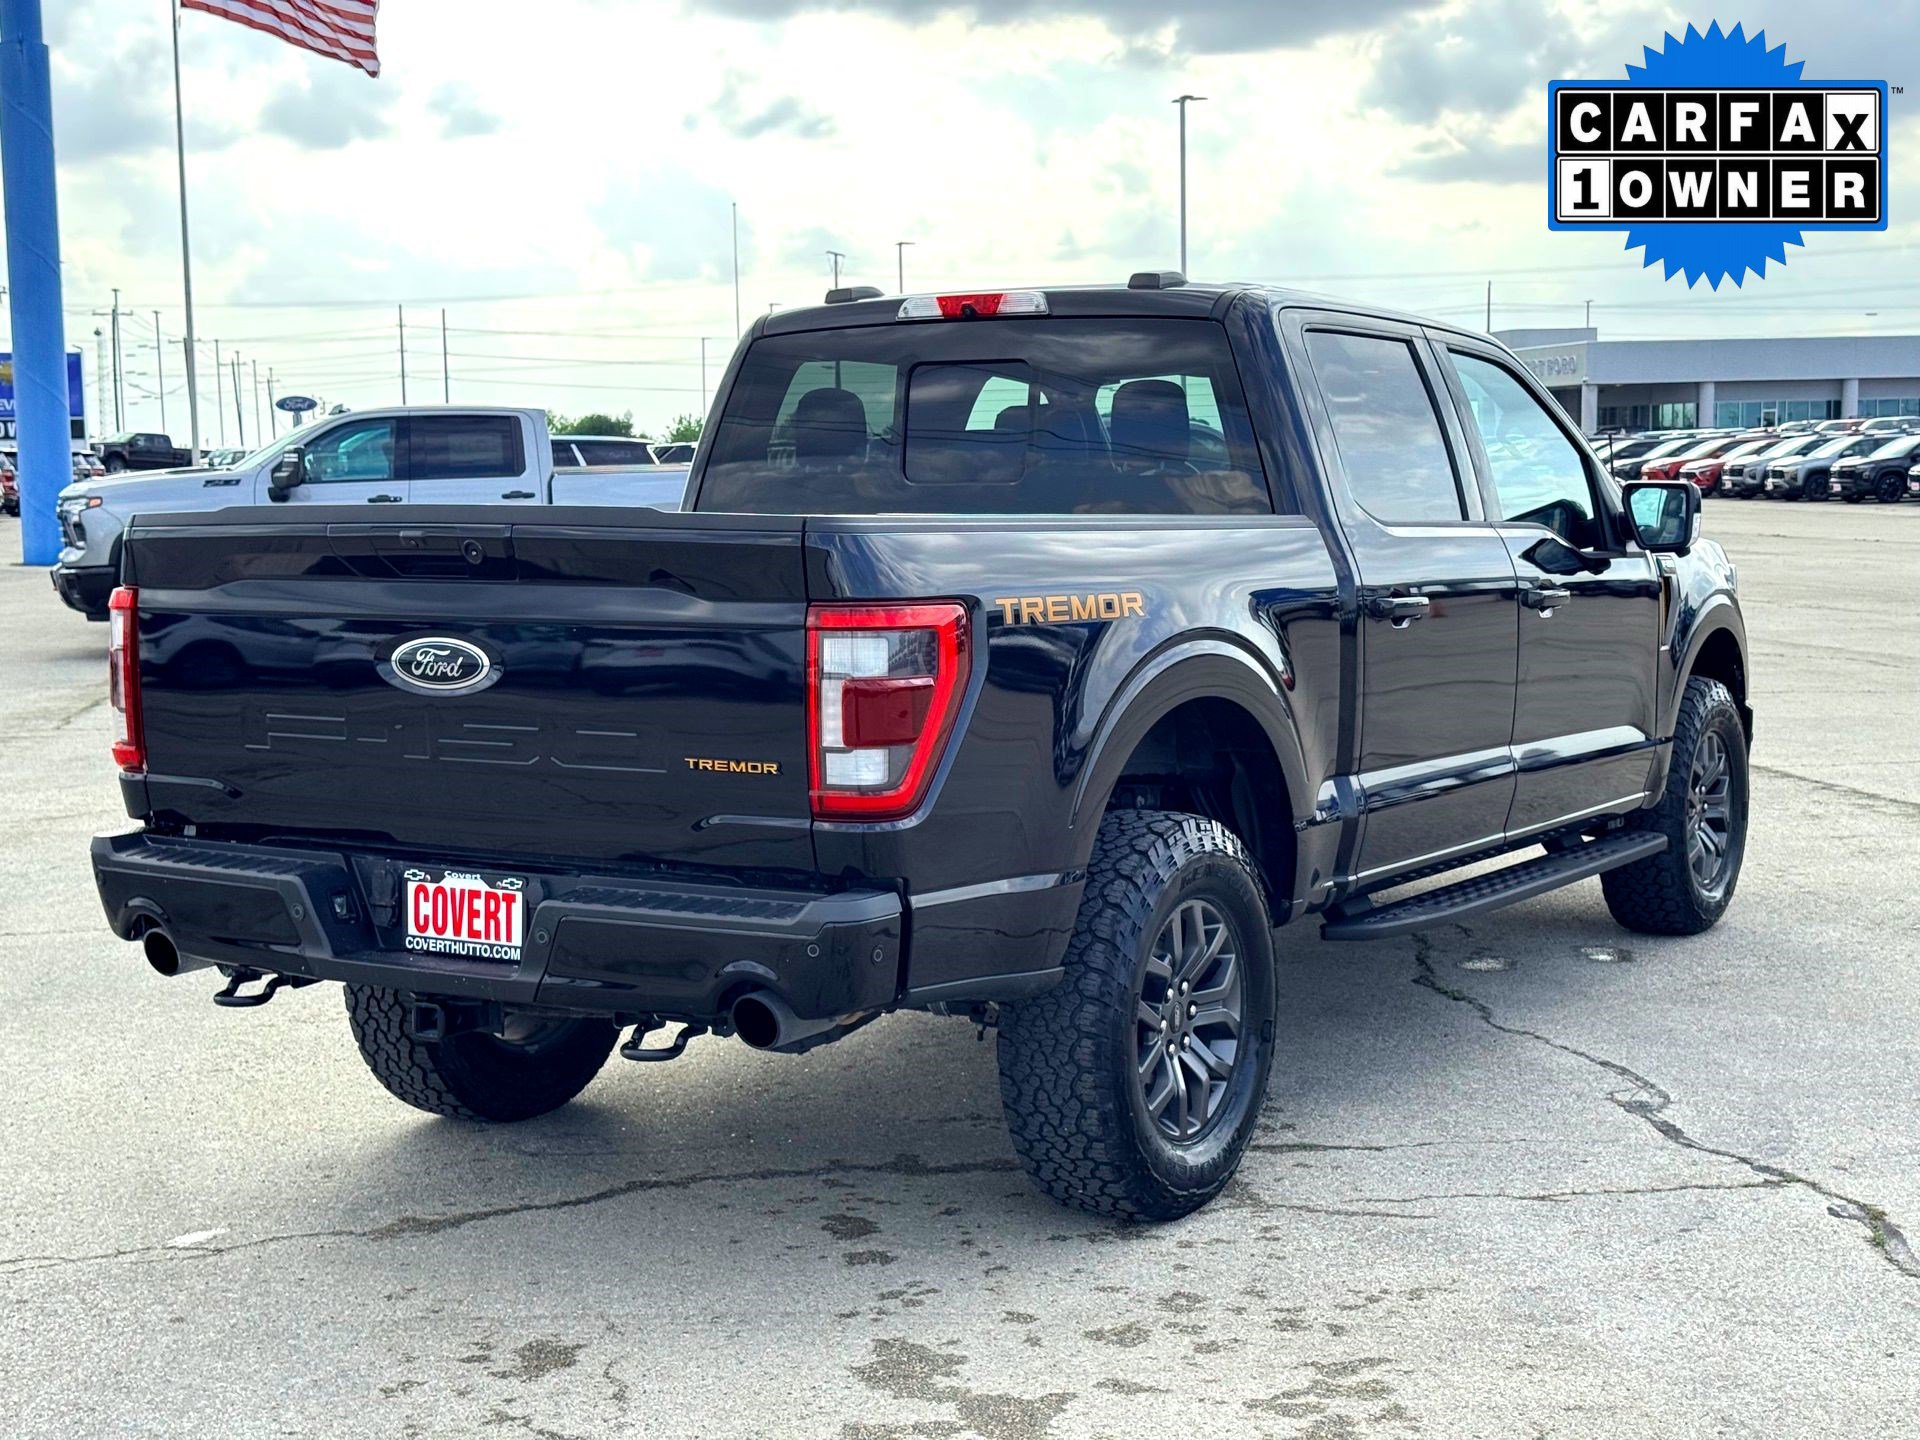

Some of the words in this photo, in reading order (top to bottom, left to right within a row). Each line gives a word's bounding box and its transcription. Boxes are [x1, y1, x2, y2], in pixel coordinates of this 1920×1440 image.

[994, 591, 1146, 626] TREMOR
[411, 647, 464, 678] Ford
[684, 757, 779, 775] TREMOR
[444, 870, 481, 881] Covert
[413, 883, 517, 944] COVERT
[405, 936, 521, 961] COVERTHUTTO.COM
